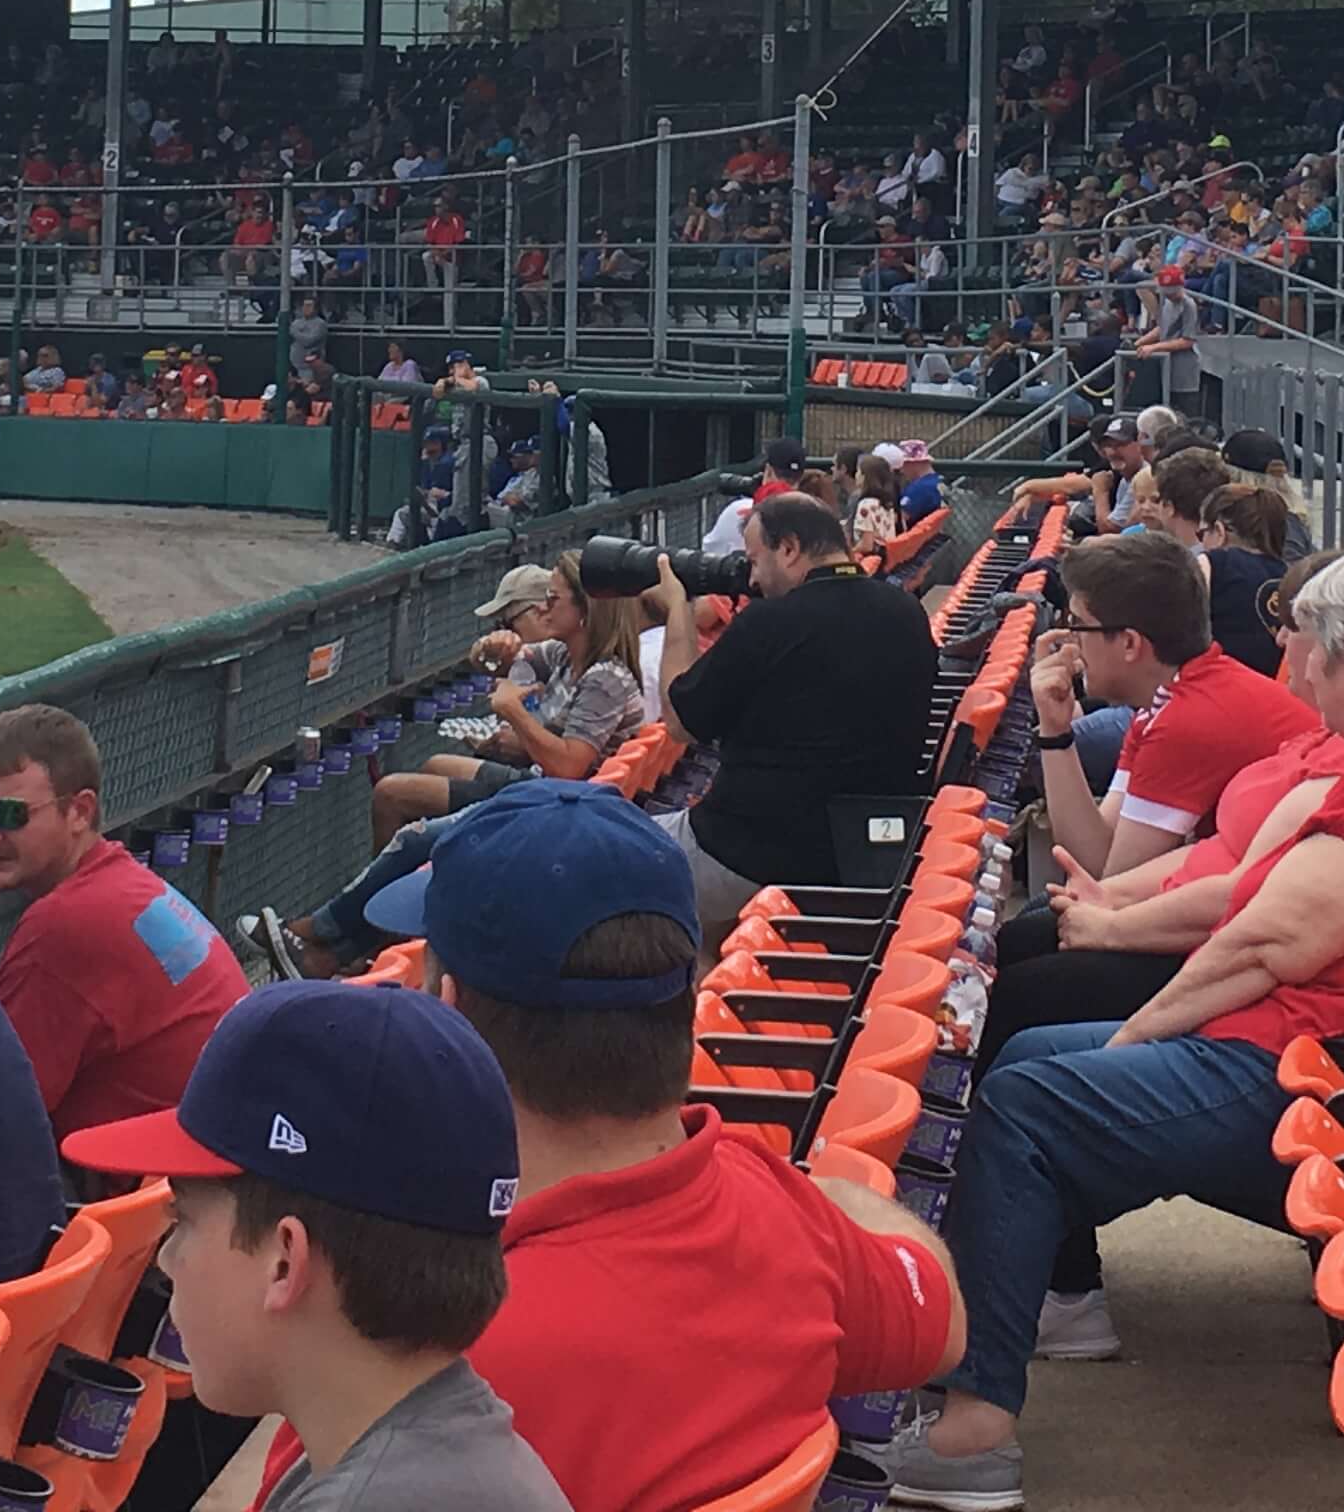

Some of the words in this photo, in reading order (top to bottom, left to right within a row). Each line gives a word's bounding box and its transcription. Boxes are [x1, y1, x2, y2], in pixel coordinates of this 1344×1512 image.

[763, 40, 773, 60] 3
[969, 132, 977, 154] 4
[106, 149, 116, 169] 2
[881, 820, 891, 839] 2
